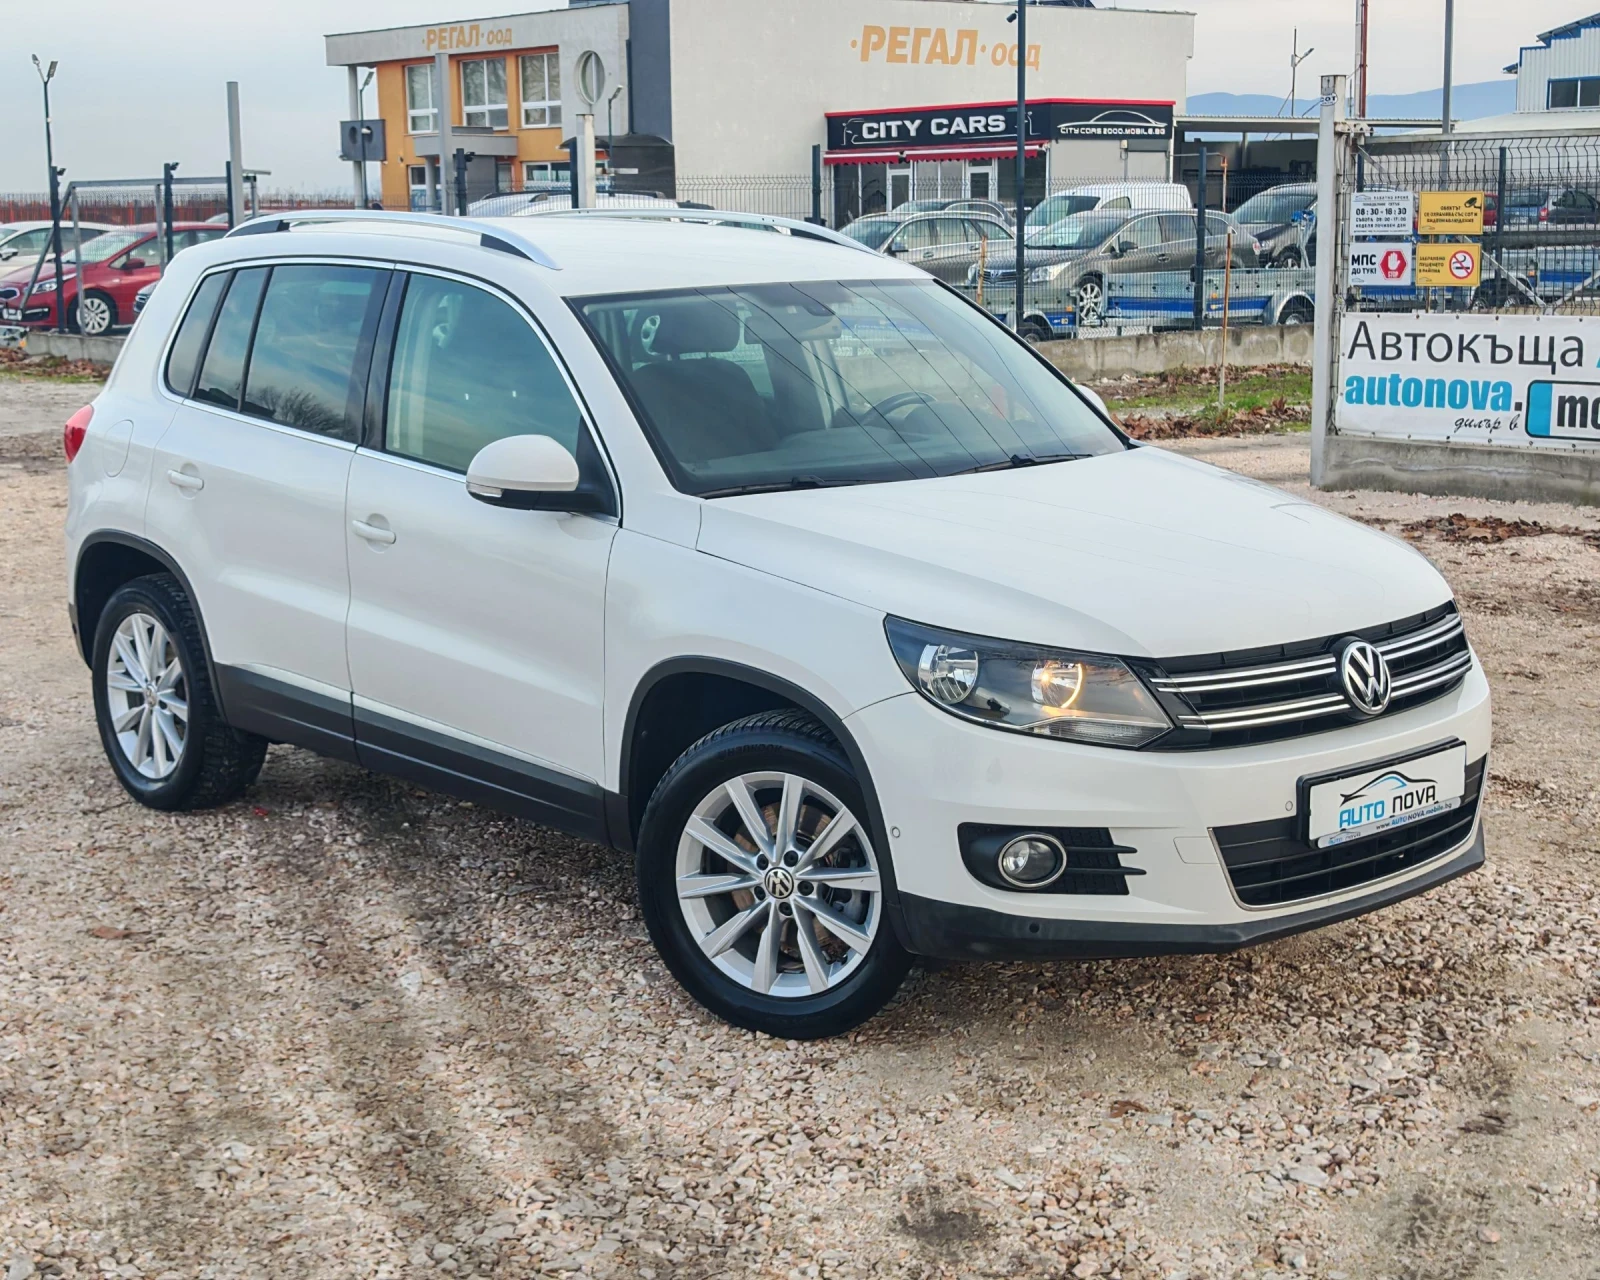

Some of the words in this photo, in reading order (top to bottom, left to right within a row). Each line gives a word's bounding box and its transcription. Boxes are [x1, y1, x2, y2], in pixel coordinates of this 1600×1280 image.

[426, 24, 480, 51] РЕГАЛ
[860, 25, 979, 66] РЕГАЛ
[862, 120, 923, 139] CITY
[930, 115, 1006, 135] CARS
[1352, 254, 1376, 266] МПС
[1347, 320, 1584, 375] Автокъща
[1454, 414, 1502, 433] дилър
[1339, 800, 1385, 828] AUTO
[1392, 785, 1436, 814] NOVA
